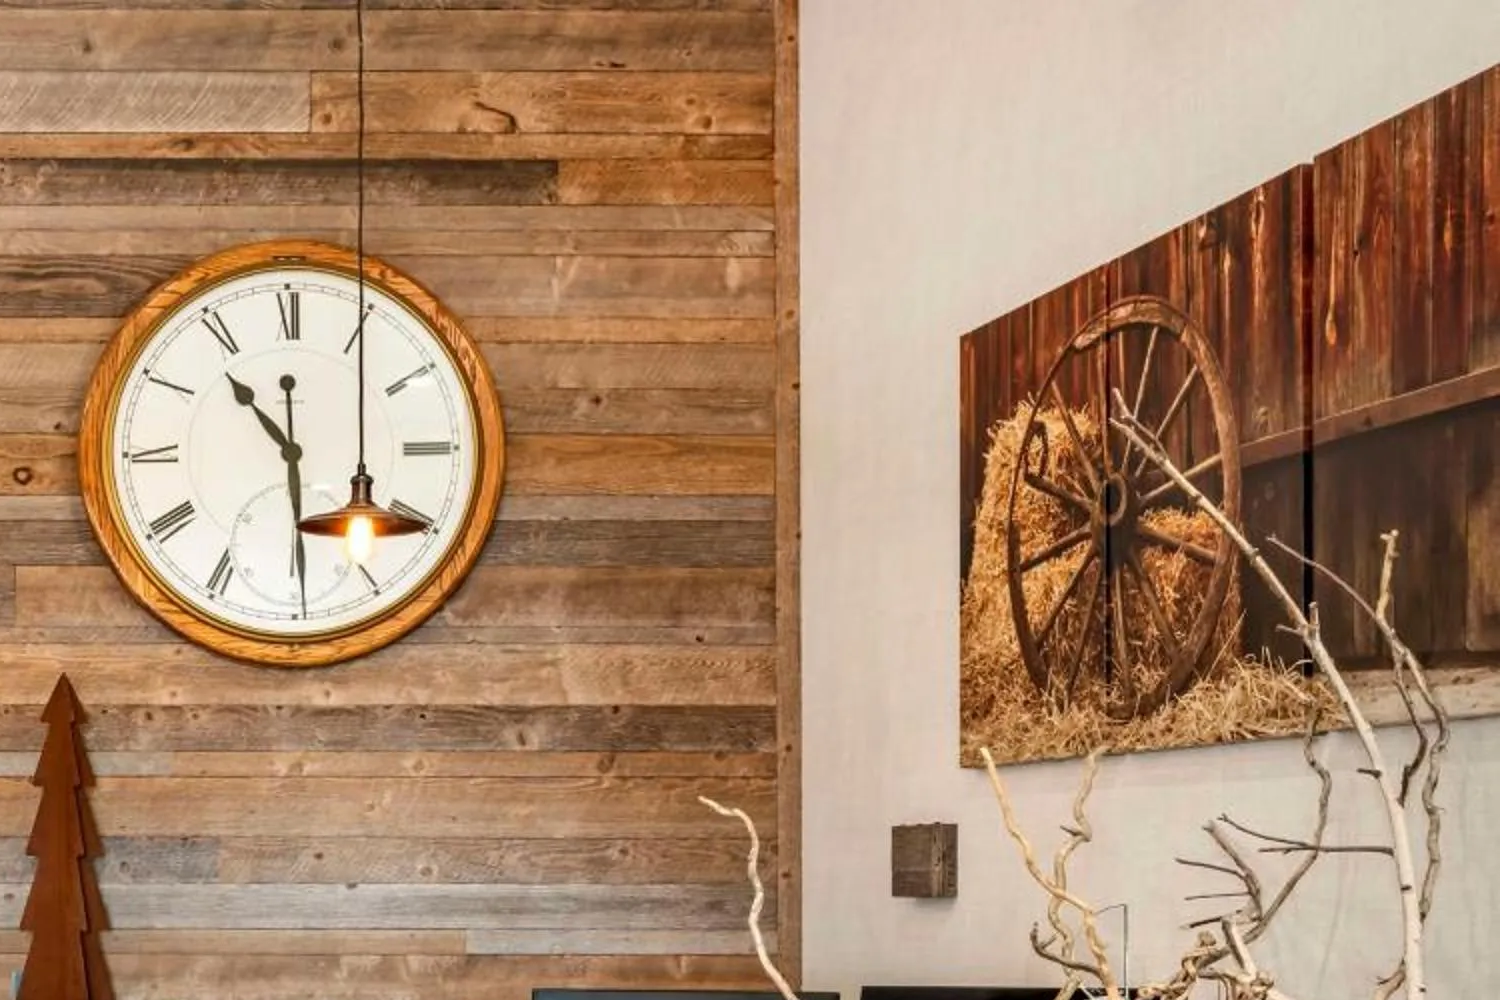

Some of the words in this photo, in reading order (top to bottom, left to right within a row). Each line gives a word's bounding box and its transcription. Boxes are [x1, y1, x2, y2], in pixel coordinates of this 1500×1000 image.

[275, 291, 301, 342] XII
[402, 441, 452, 456] III
[149, 500, 199, 545] VIII
